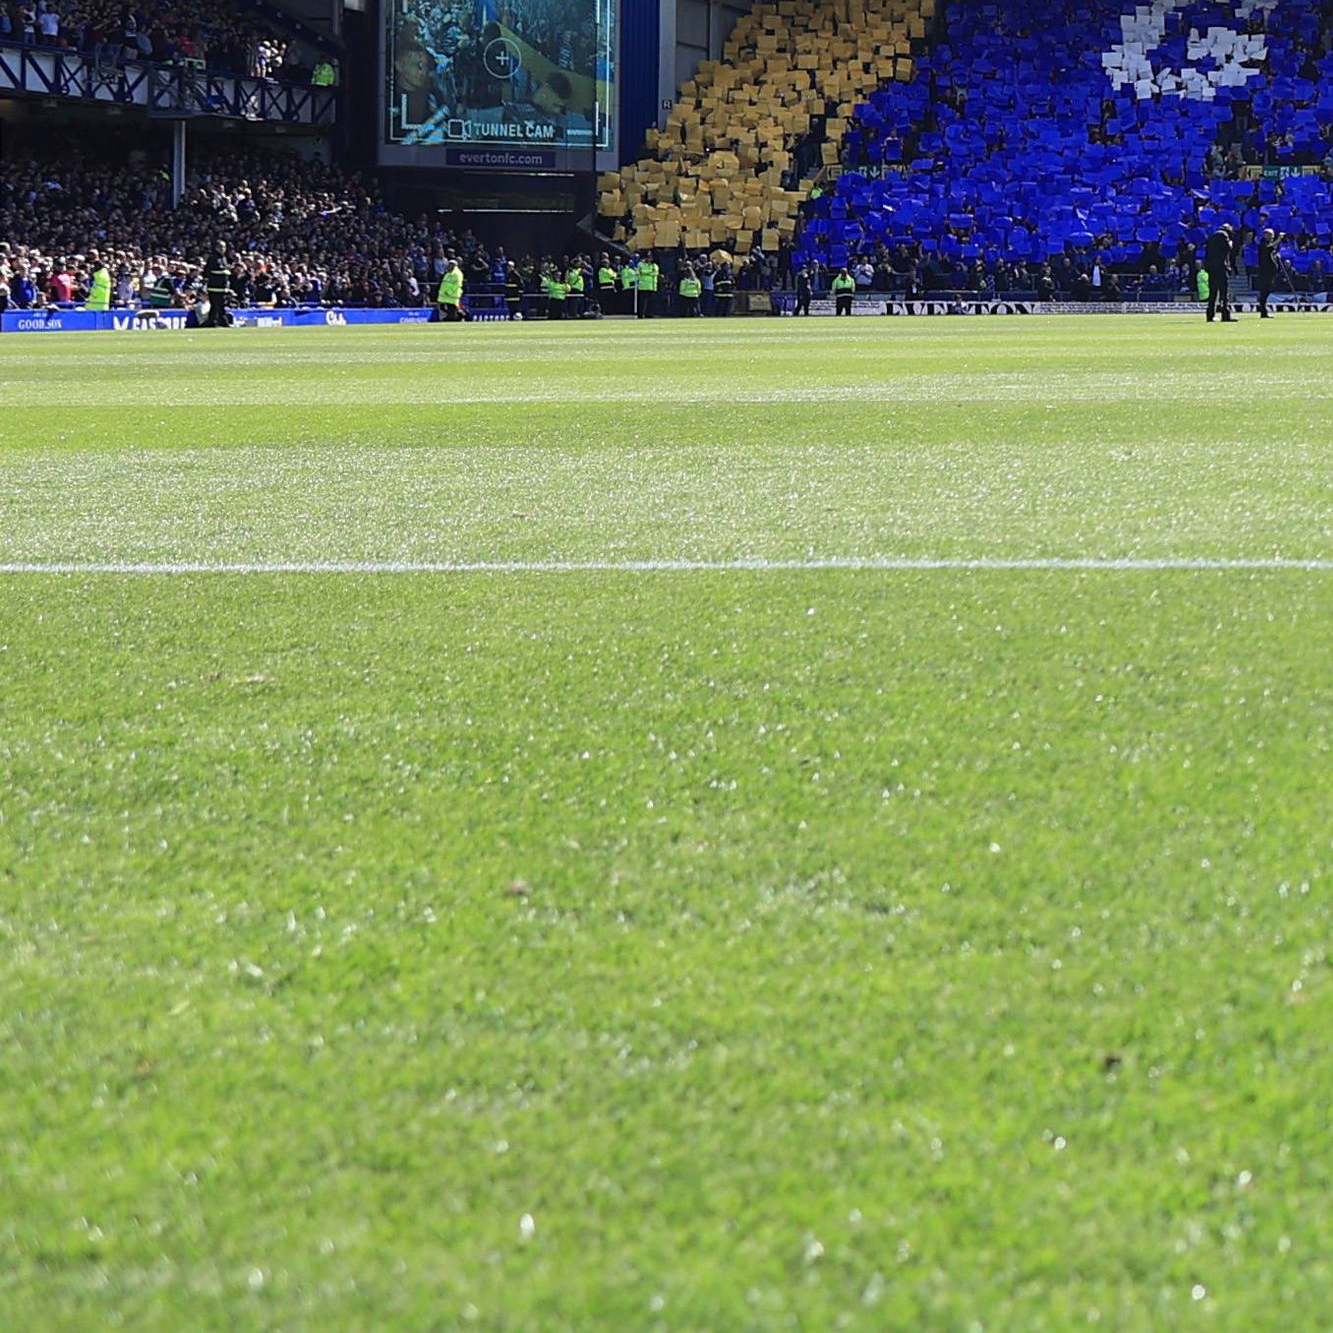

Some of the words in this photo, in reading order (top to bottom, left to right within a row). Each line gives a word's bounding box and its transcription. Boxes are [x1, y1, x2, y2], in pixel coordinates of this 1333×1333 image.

[473, 123, 523, 137] TUNNEL
[526, 125, 554, 138] CAM
[460, 152, 543, 164] evertonfc.com
